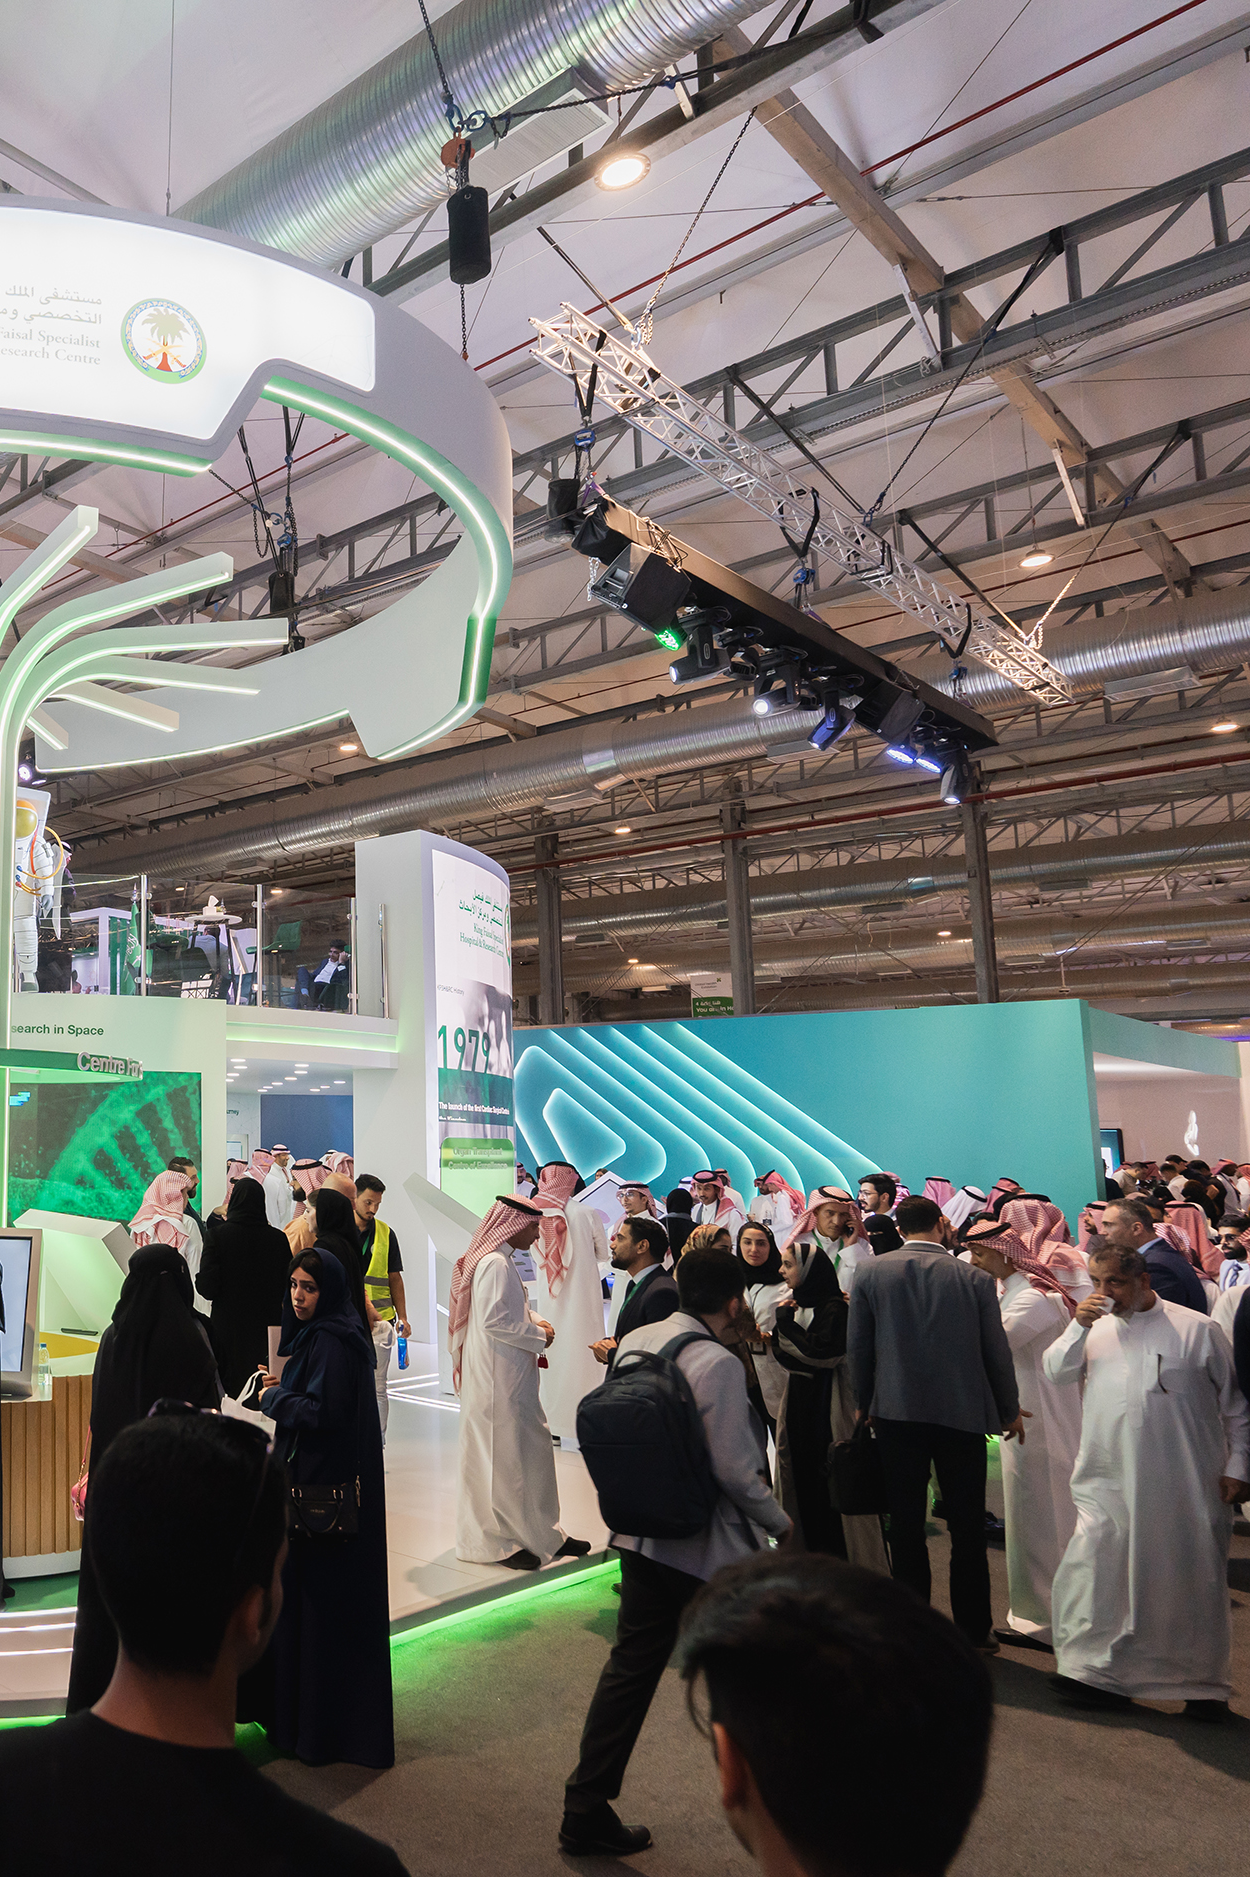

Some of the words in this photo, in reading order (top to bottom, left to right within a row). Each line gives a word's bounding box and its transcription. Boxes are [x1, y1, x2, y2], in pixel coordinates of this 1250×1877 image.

[5, 285, 35, 298] الملك
[39, 288, 102, 305] مستشفى
[23, 309, 102, 325] التخصصي
[37, 329, 101, 349] Specialist
[54, 348, 101, 365] Centre
[54, 1024, 64, 1034] in
[68, 1024, 104, 1037] Space
[438, 1025, 491, 1074] 1979
[77, 1051, 125, 1075] Centre
[439, 1102, 447, 1110] The
[472, 1147, 503, 1157] Transplant
[448, 1161, 469, 1170] Centre
[469, 1161, 476, 1169] of
[477, 1161, 508, 1170] Excellence
